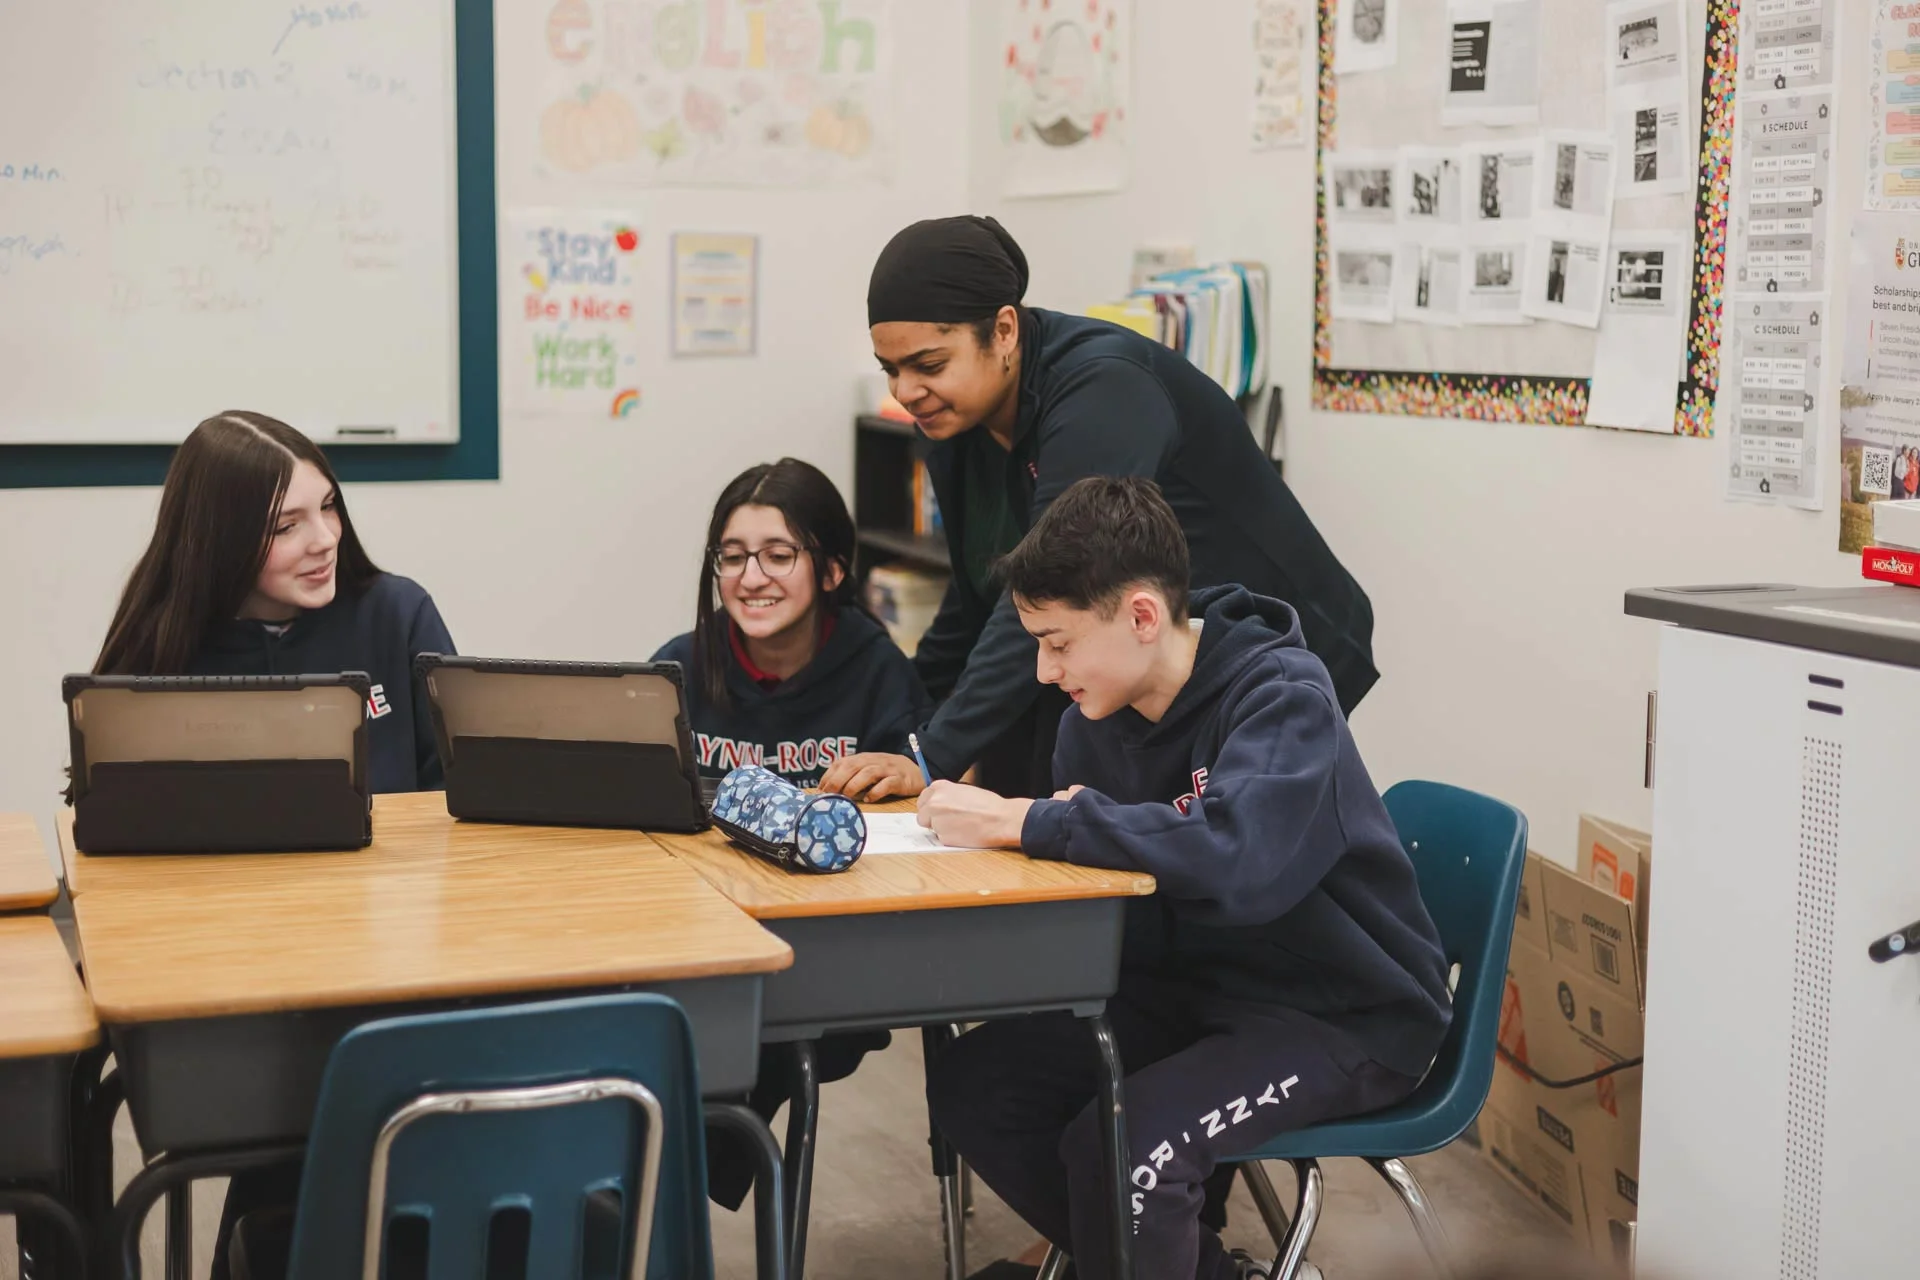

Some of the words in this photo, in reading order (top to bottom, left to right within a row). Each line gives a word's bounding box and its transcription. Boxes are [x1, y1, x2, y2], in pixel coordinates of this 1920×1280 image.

[1769, 121, 1808, 132] SCHEDULE
[538, 227, 613, 262] Stay
[548, 258, 616, 285] Kind
[1908, 251, 1920, 268] G
[524, 295, 560, 321] Be
[570, 295, 632, 321] Nice
[1872, 299, 1891, 310] best
[1892, 302, 1907, 312] and
[1762, 325, 1800, 334] SCHEDULE
[533, 333, 617, 363] Work
[535, 361, 616, 389] Hard
[691, 729, 858, 774] YNN-ROSE
[1131, 1074, 1299, 1235] LYNN-ROS
